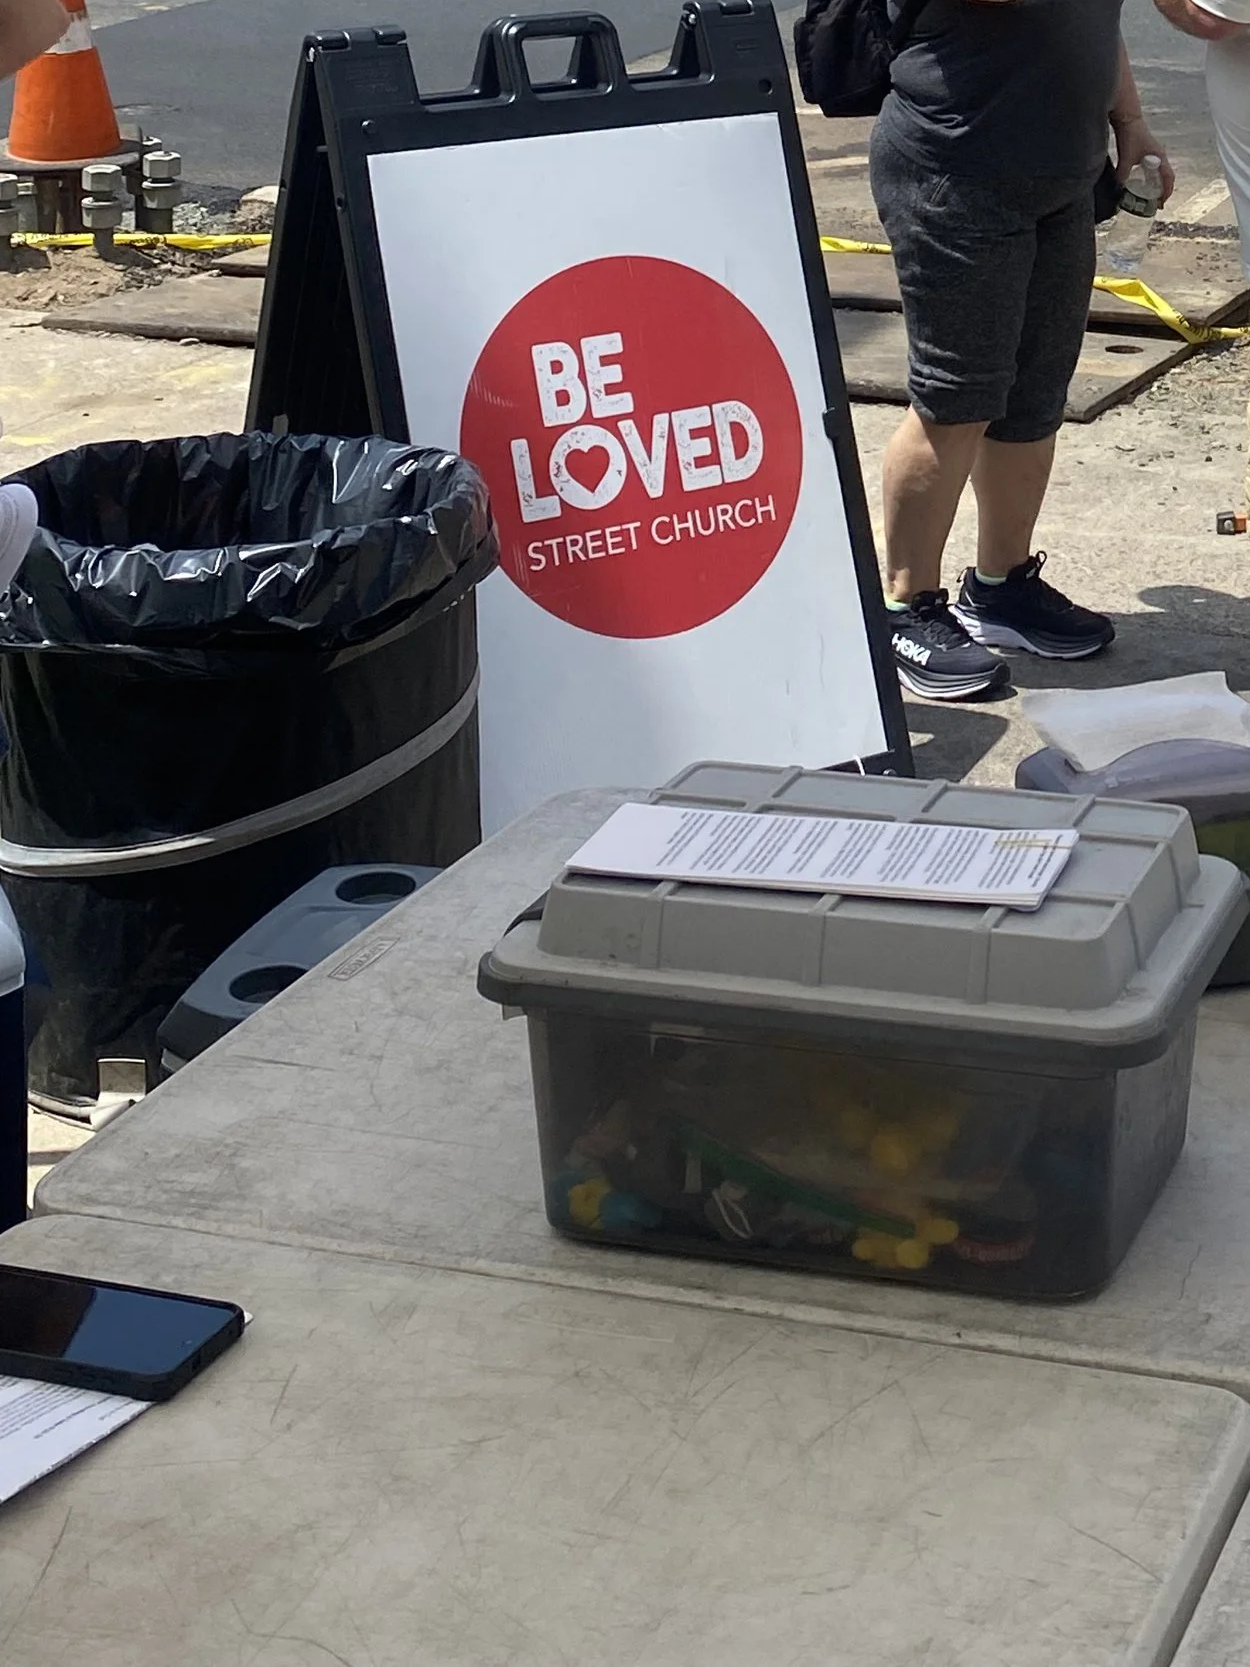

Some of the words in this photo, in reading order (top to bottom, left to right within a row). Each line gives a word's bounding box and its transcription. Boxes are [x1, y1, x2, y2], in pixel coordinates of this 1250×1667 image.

[531, 332, 634, 427] BE
[510, 399, 764, 524] LOVED
[526, 522, 641, 572] STREET
[650, 495, 777, 546] CHURCH
[891, 632, 931, 666] HOKA
